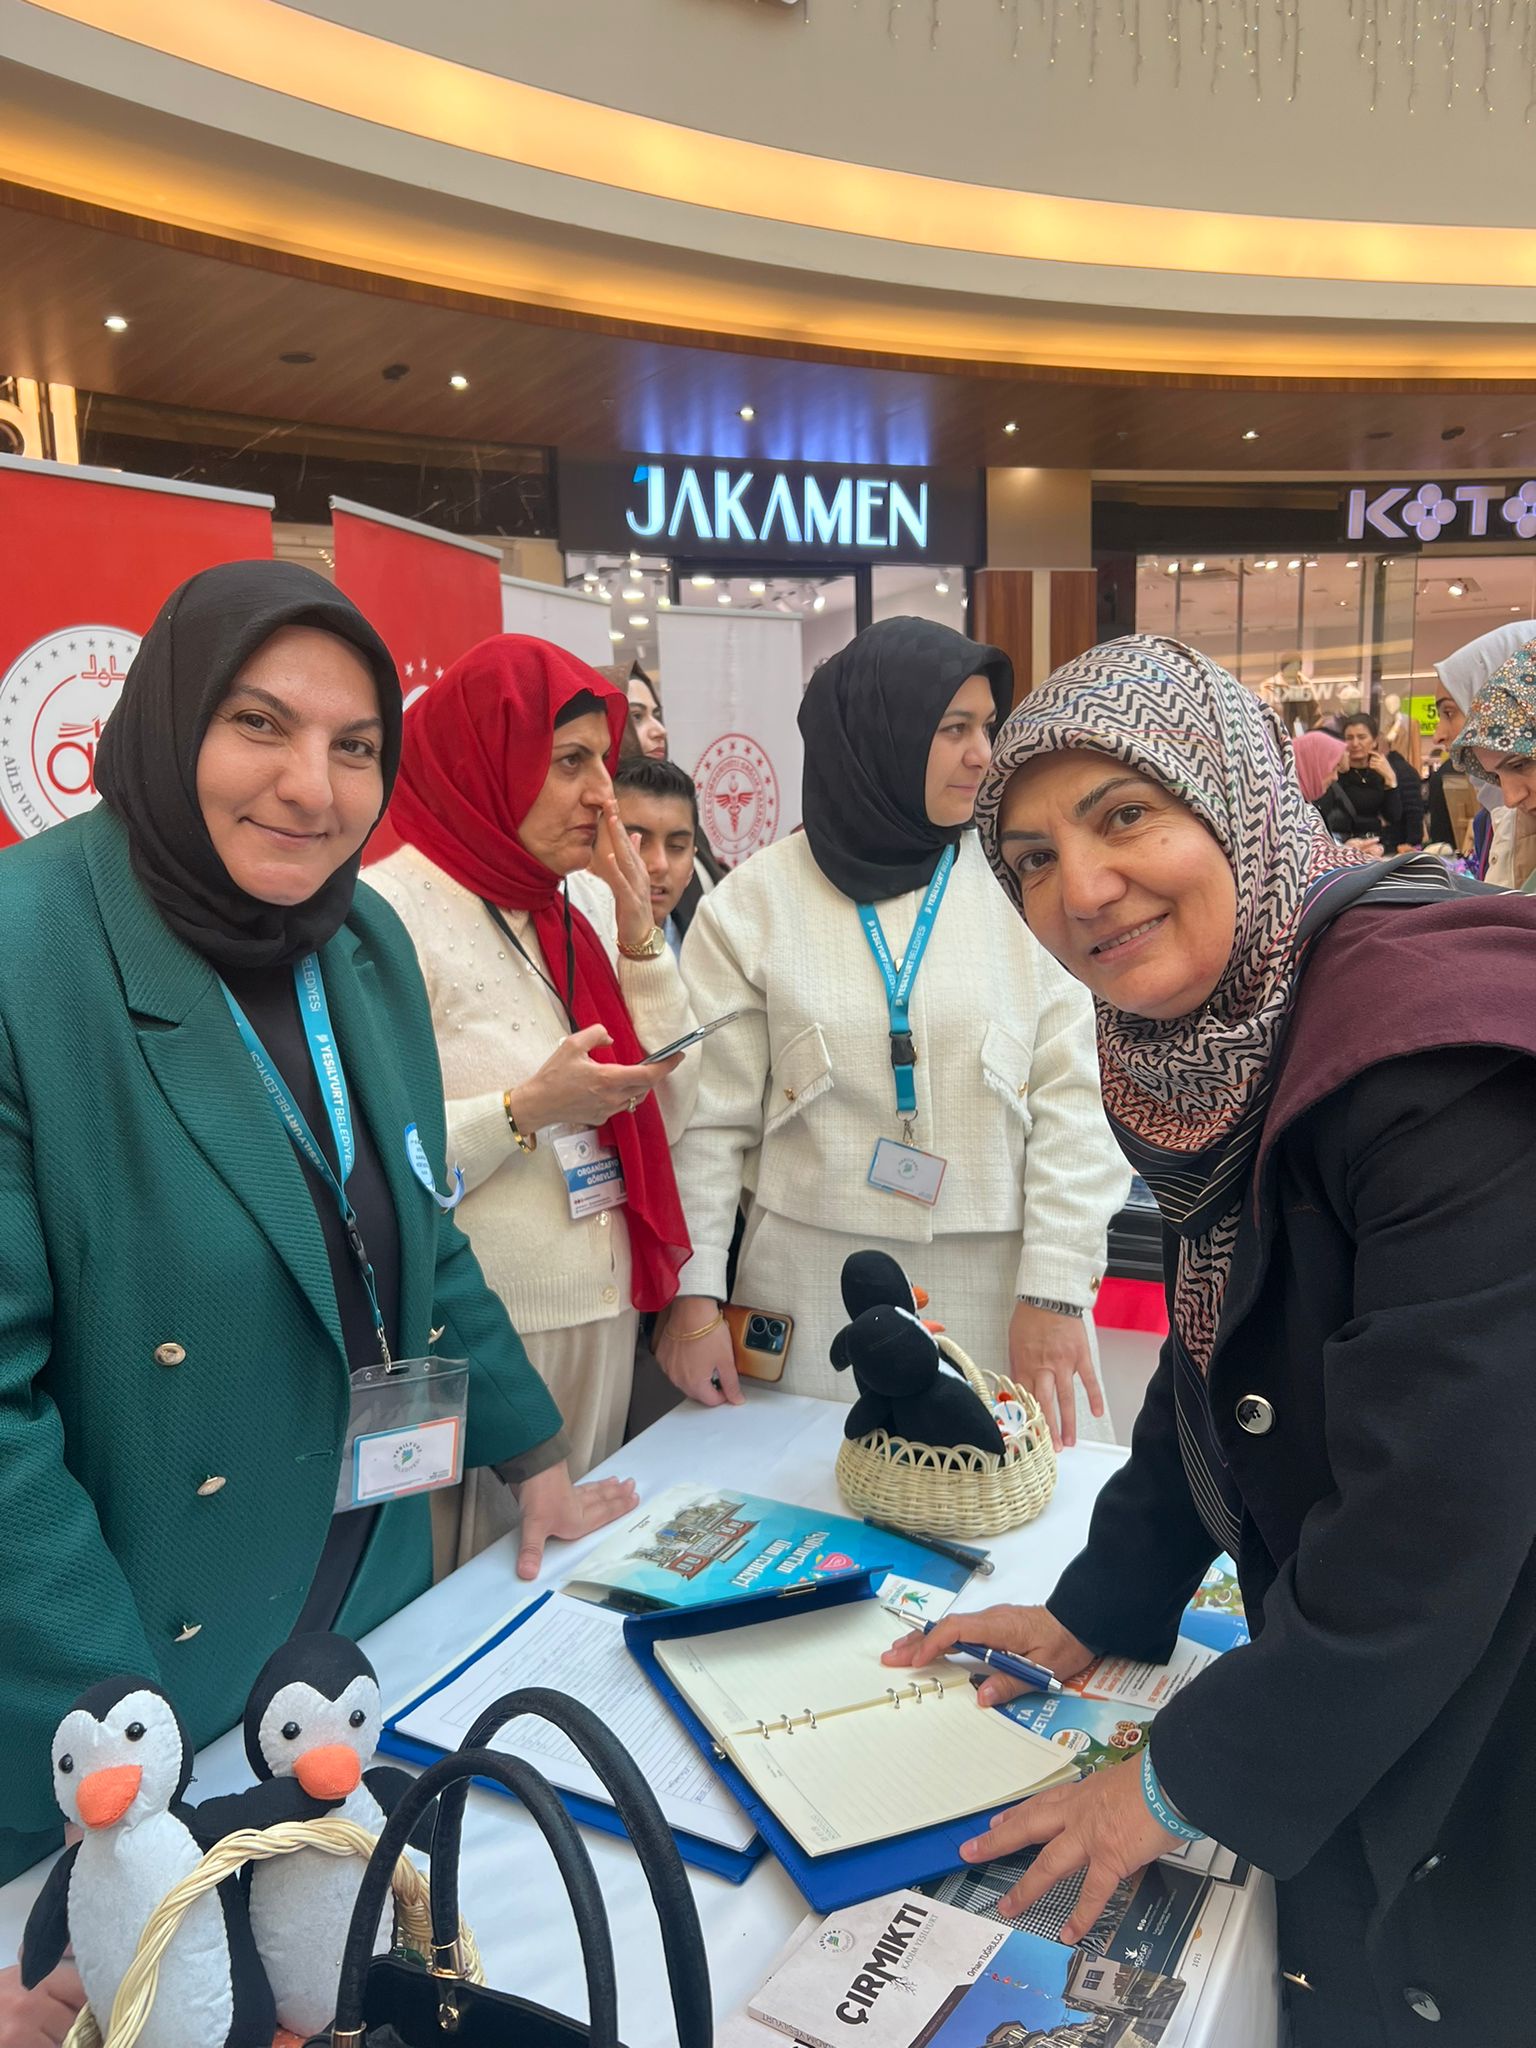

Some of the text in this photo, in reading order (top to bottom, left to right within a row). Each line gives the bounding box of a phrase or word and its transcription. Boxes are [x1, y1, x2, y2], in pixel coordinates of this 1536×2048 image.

[626, 465, 927, 547] JAKAMEN
[4, 754, 22, 793] AİLE
[15, 793, 36, 817] VE
[320, 1045, 345, 1106] YEŞİLYURT
[576, 1159, 619, 1177] ORGANİZASYO
[835, 1903, 929, 2026] ÇIRMIKTI
[901, 1945, 920, 1970] KADİM
[966, 1960, 984, 1977] Orhan
